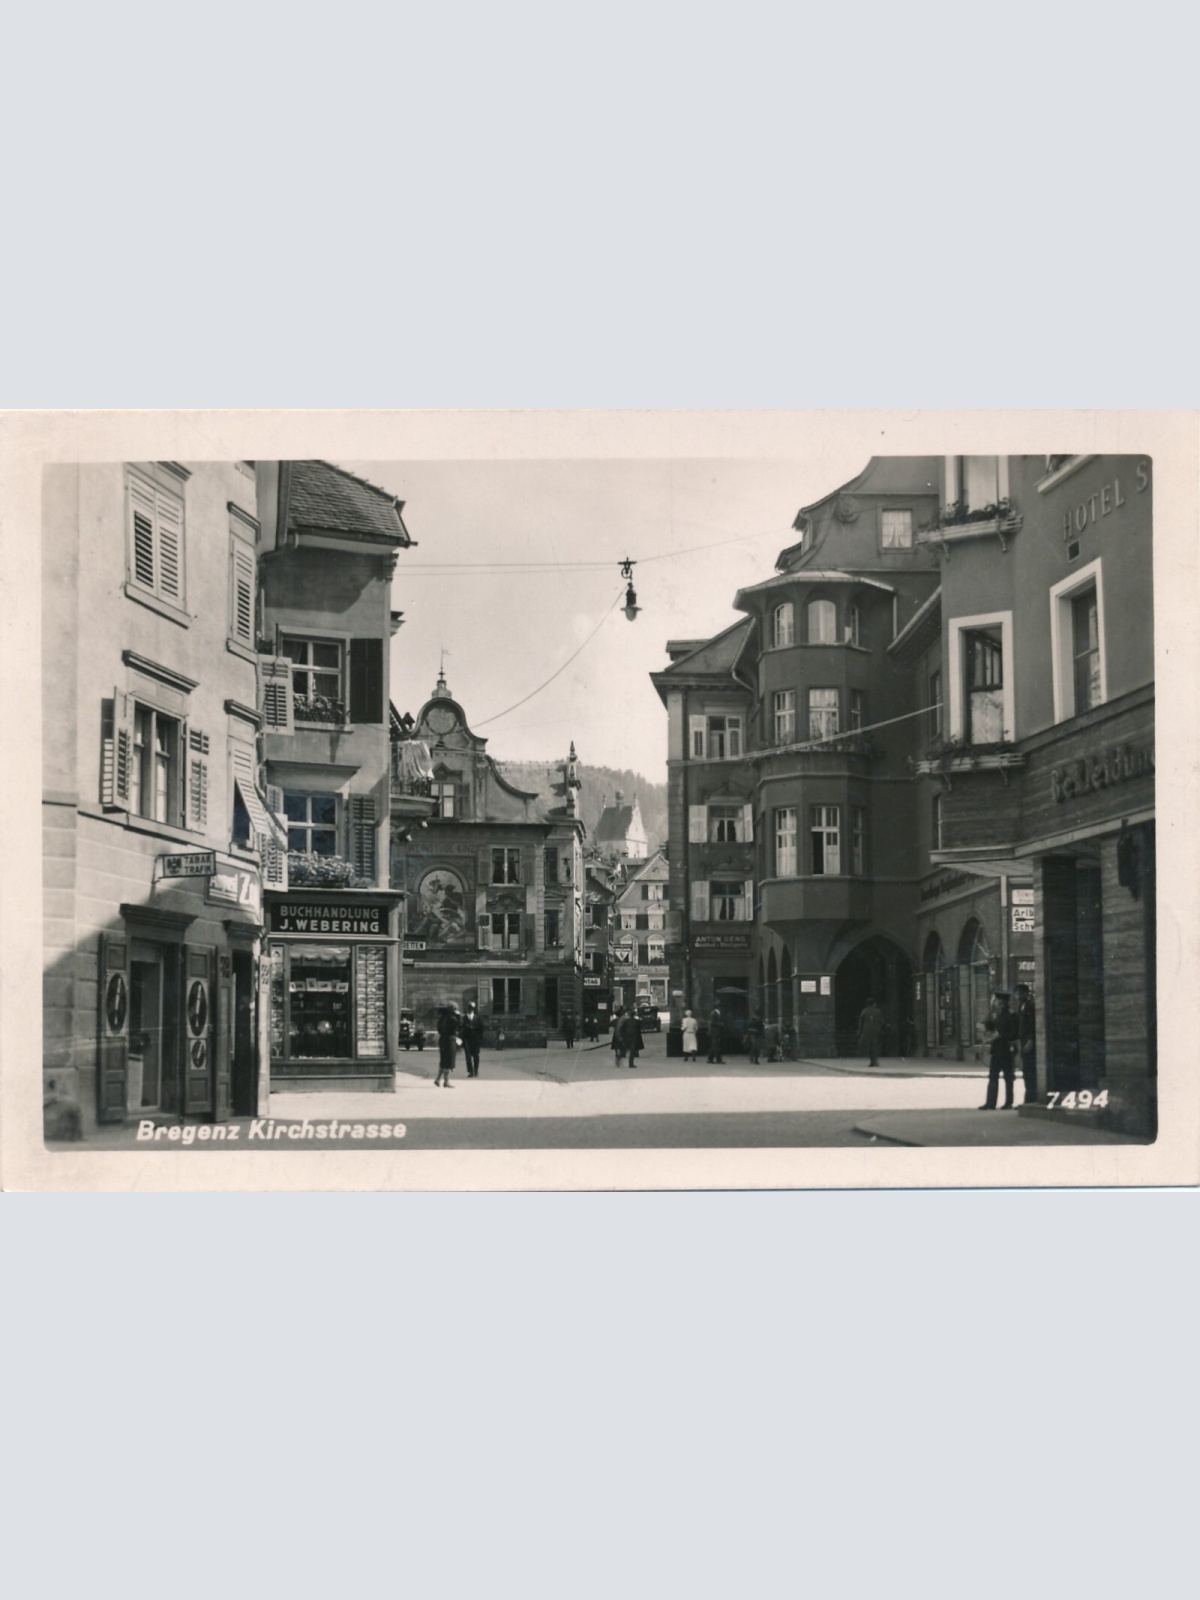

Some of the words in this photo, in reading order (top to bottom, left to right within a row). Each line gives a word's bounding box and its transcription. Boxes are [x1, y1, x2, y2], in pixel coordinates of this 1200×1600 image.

[1063, 478, 1125, 541] HOTEL
[184, 855, 211, 865] TABAK
[184, 865, 213, 874] TRAFIK
[280, 905, 379, 919] BUCHHANDLUNG
